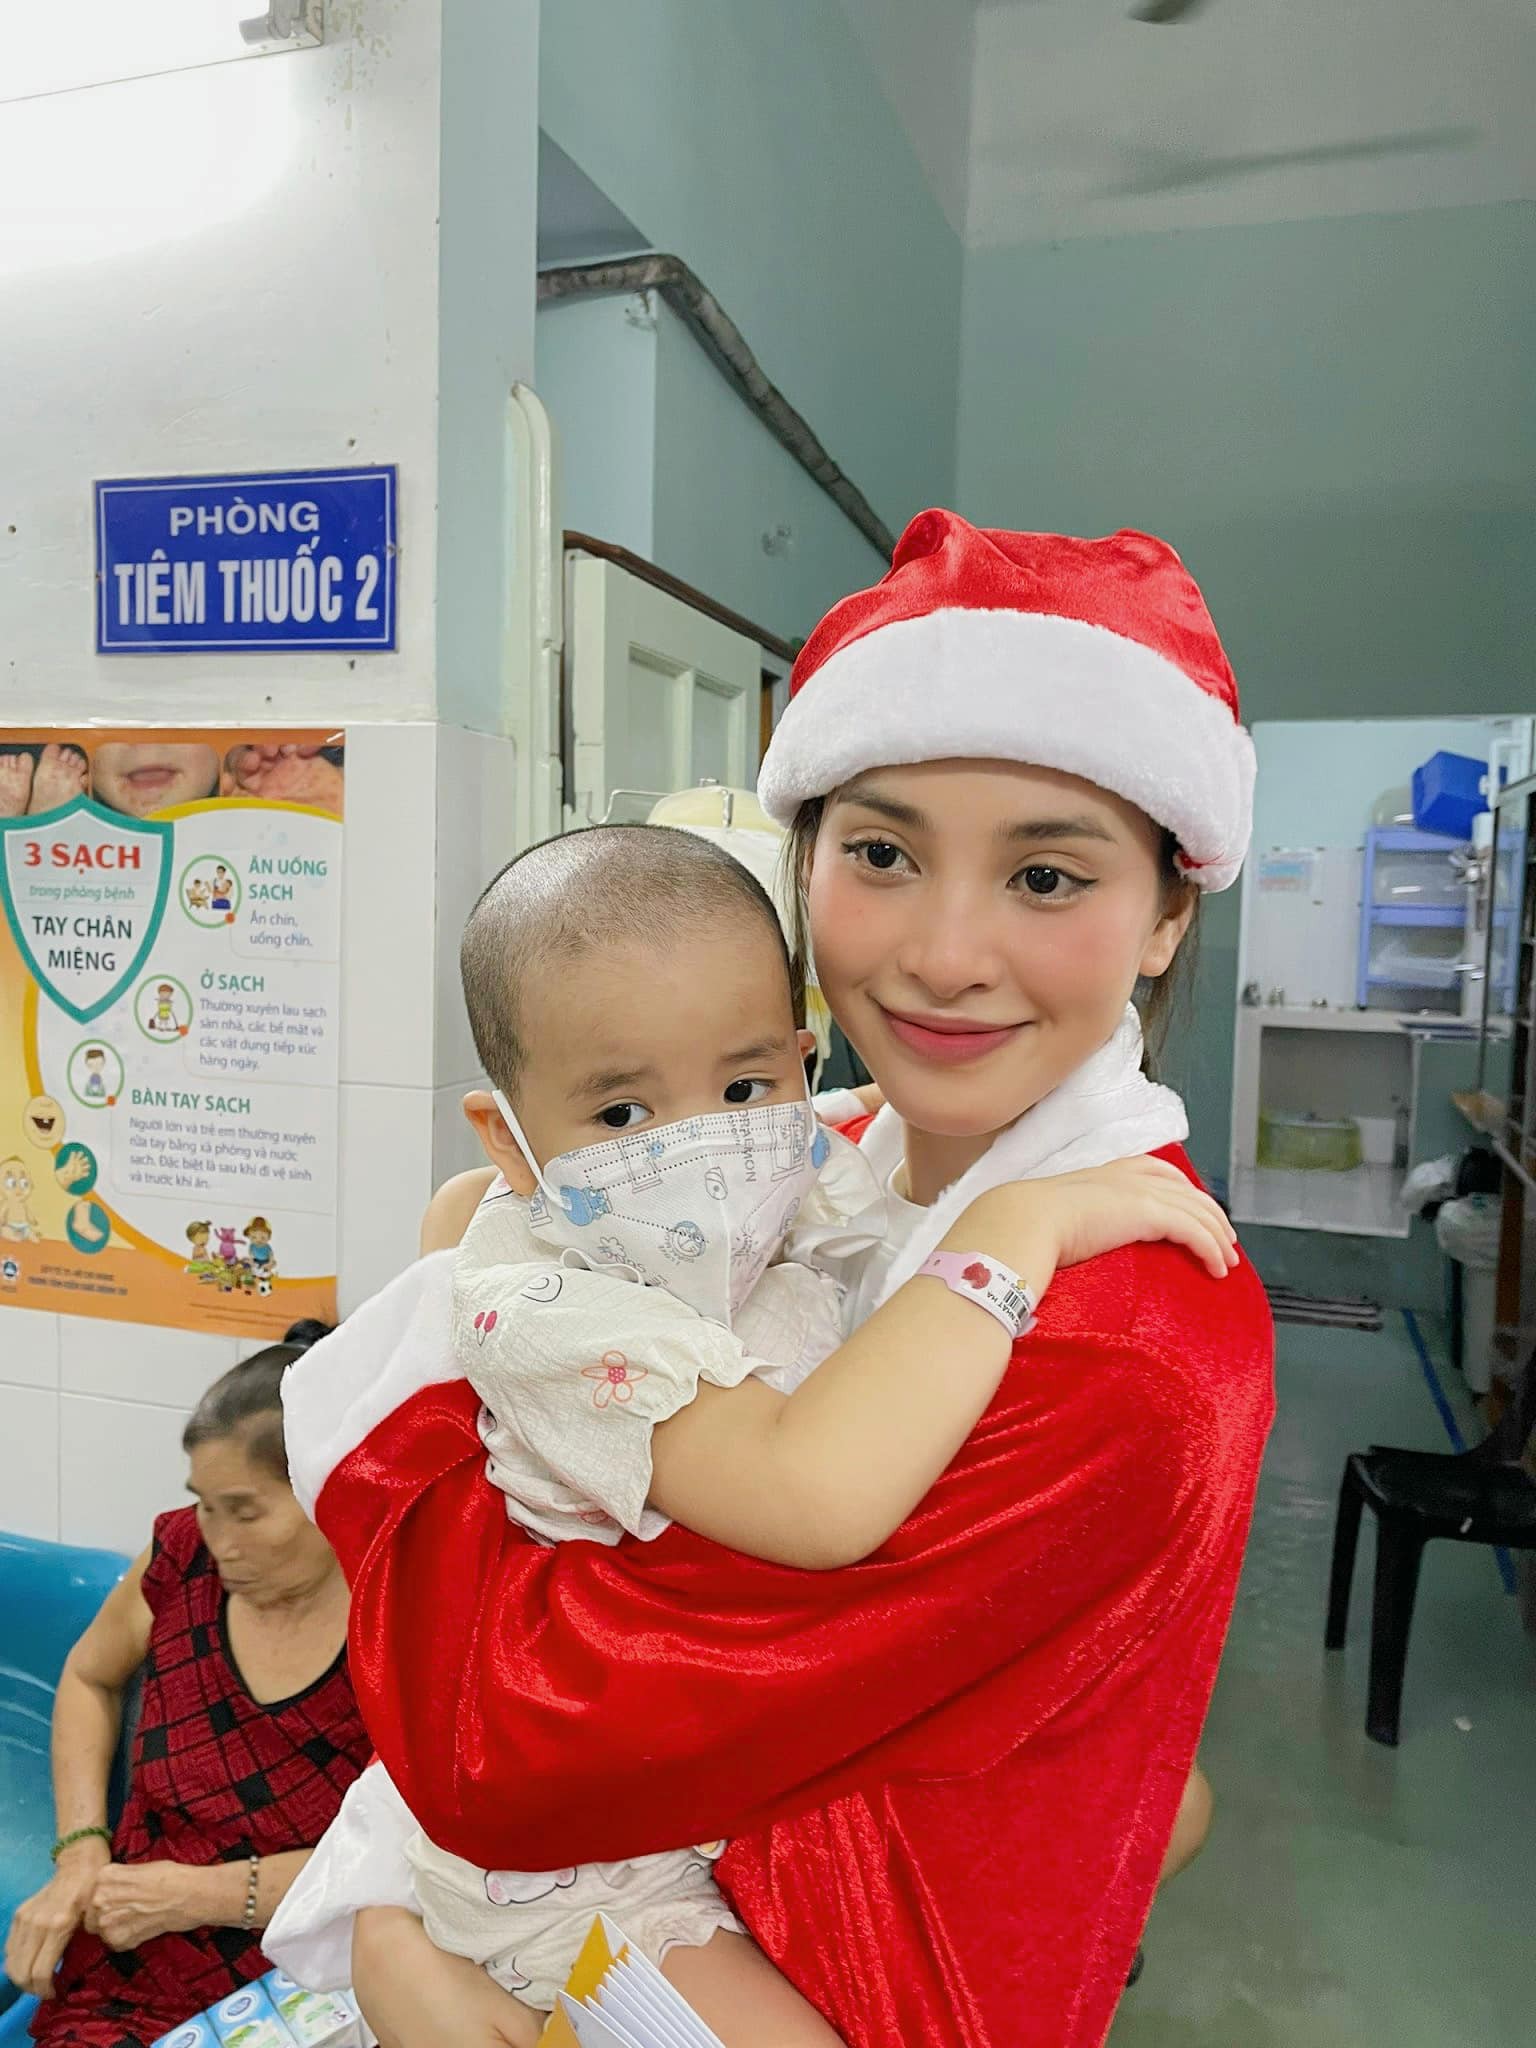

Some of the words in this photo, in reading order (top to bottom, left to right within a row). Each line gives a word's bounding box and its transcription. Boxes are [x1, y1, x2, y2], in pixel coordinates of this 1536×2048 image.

[169, 496, 320, 537] PHÒNG
[114, 548, 206, 626] TIÊM
[218, 536, 343, 624] THUỐC
[354, 554, 380, 622] 2
[24, 842, 42, 868] 3
[51, 843, 141, 875] SẠCH
[248, 854, 273, 874] ĂN
[278, 854, 327, 876] UỐNG
[29, 885, 61, 901] trong
[64, 885, 102, 902] phòng
[104, 886, 135, 901] bệnh
[248, 884, 293, 904] SẠCH
[32, 916, 68, 936] TAY
[73, 915, 132, 939] CHÂN
[250, 931, 281, 949] uống
[48, 946, 115, 977] MIỆNG
[200, 968, 215, 990] Ở
[218, 974, 265, 996] SẠCH
[132, 1087, 167, 1107] BÀN
[170, 1092, 200, 1110] TAY
[205, 1095, 250, 1117] SẠCH
